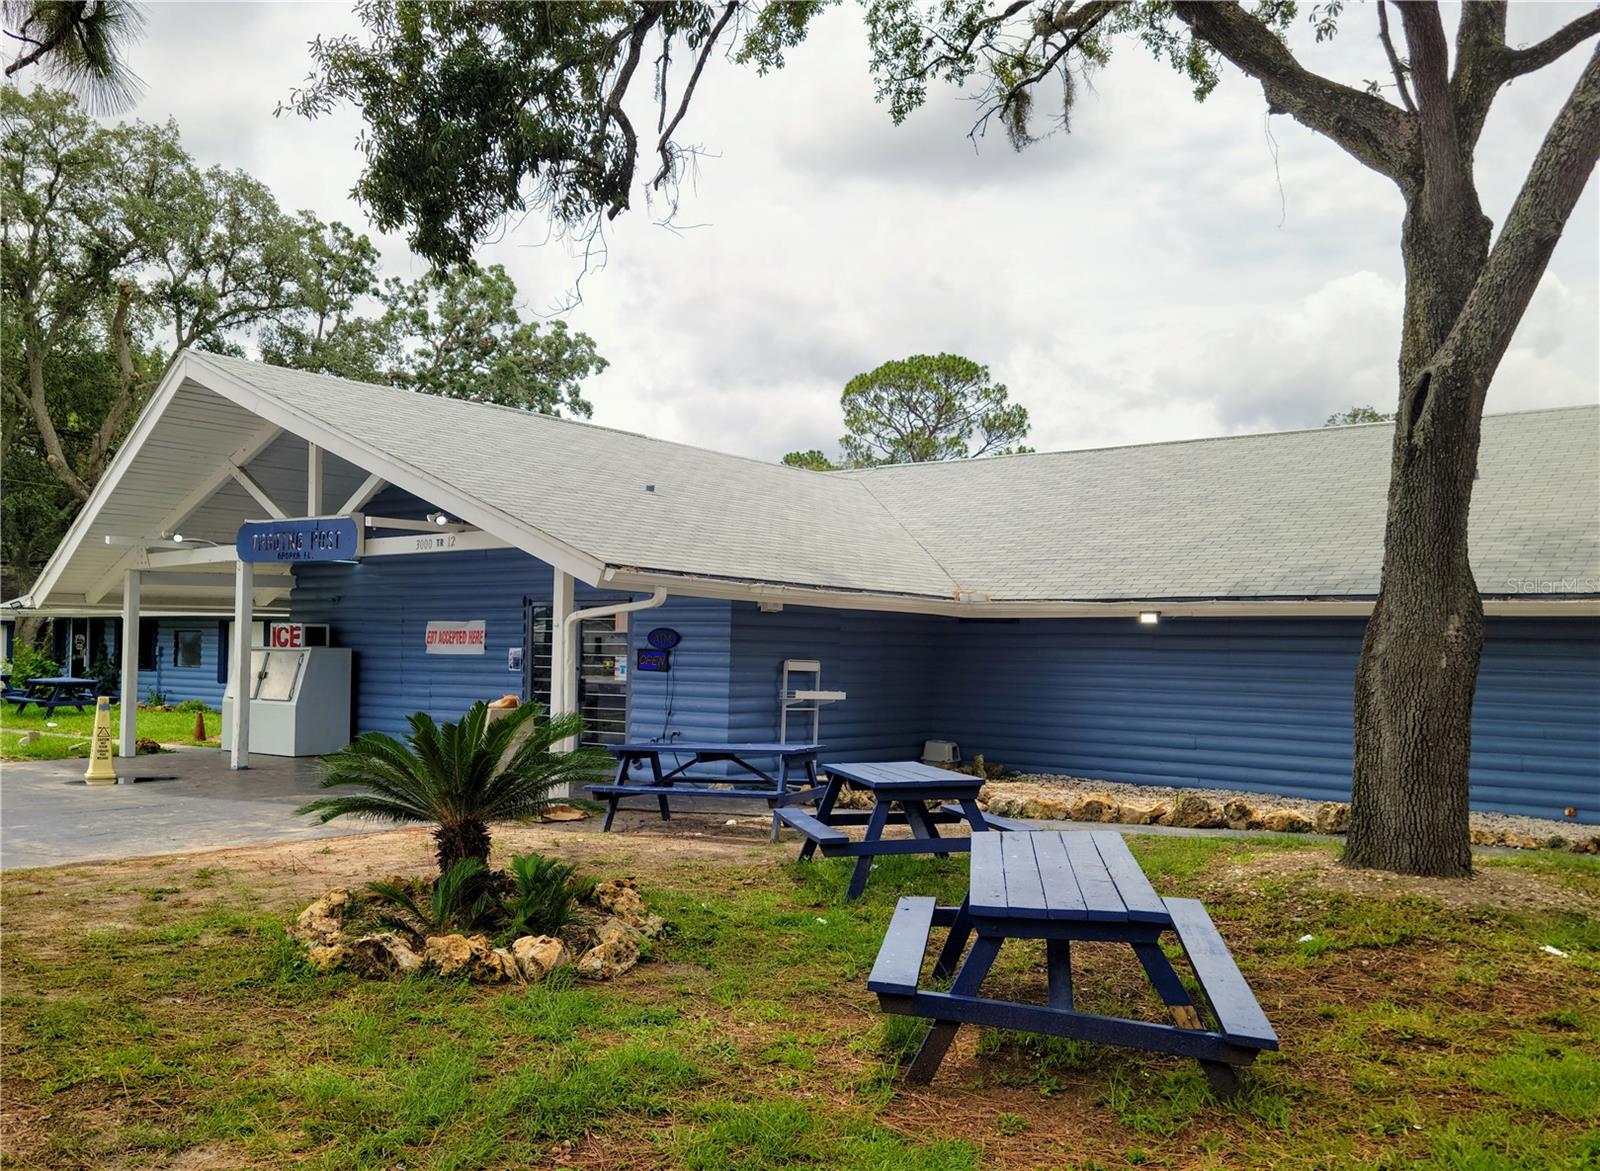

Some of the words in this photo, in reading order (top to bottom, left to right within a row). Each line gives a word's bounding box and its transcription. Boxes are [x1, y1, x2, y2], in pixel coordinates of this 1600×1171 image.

[311, 530, 342, 550] POST
[416, 539, 432, 550] 3000
[272, 625, 301, 647] ICE
[427, 630, 437, 644] EBT
[438, 630, 466, 644] ACCEPTED
[468, 630, 484, 644] HERE
